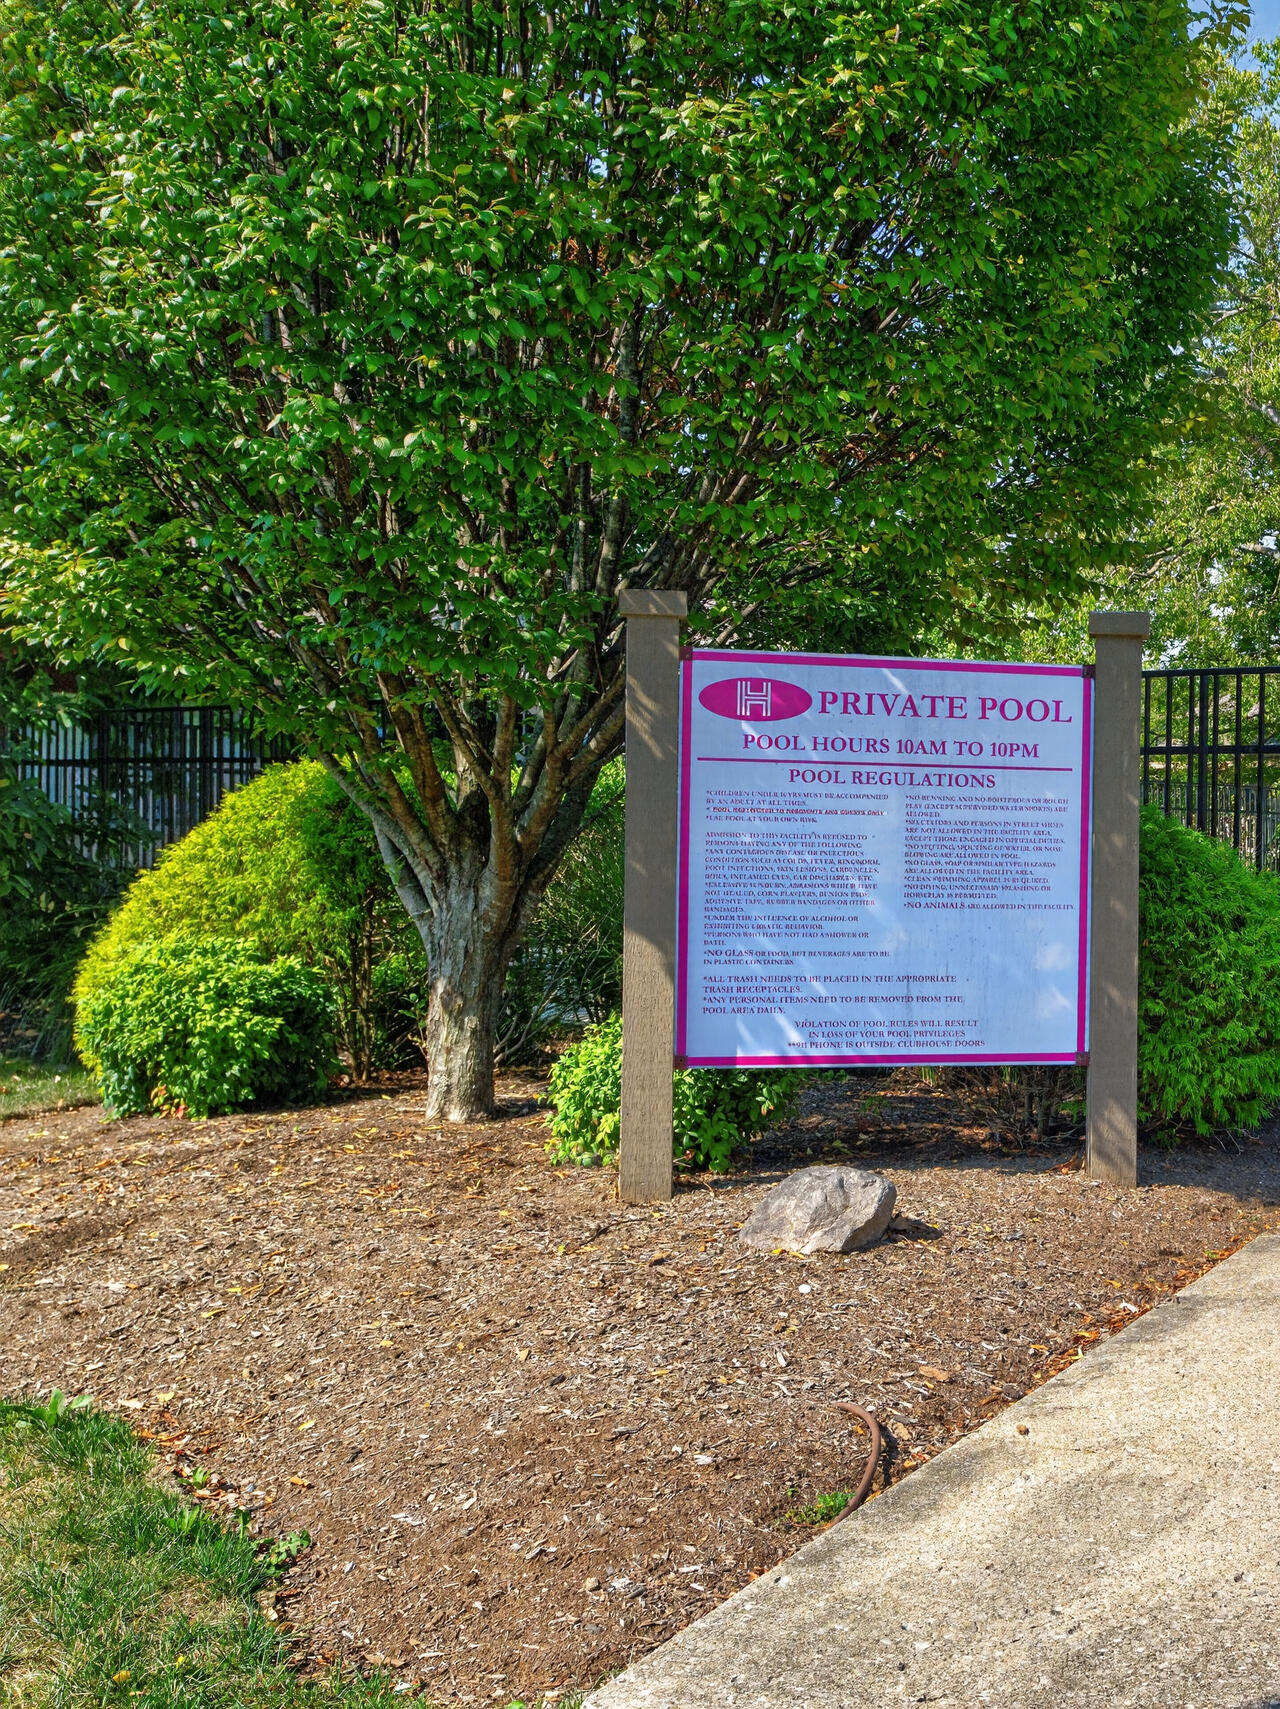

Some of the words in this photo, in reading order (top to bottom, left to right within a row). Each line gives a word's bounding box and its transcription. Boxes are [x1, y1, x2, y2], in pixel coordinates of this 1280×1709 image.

[818, 690, 966, 720] PRIVATE
[978, 696, 1073, 723] POOL
[742, 733, 805, 751] POOL
[812, 736, 889, 754] HOURS
[895, 738, 947, 756] 10AM
[953, 740, 983, 757] TO
[990, 741, 1040, 758] 10PM
[788, 768, 845, 786] POOL
[851, 770, 996, 789] REGULATIONS
[923, 901, 965, 909] ANIMALS
[730, 1006, 754, 1014] AREA
[855, 1040, 895, 1048] OUTSIDE
